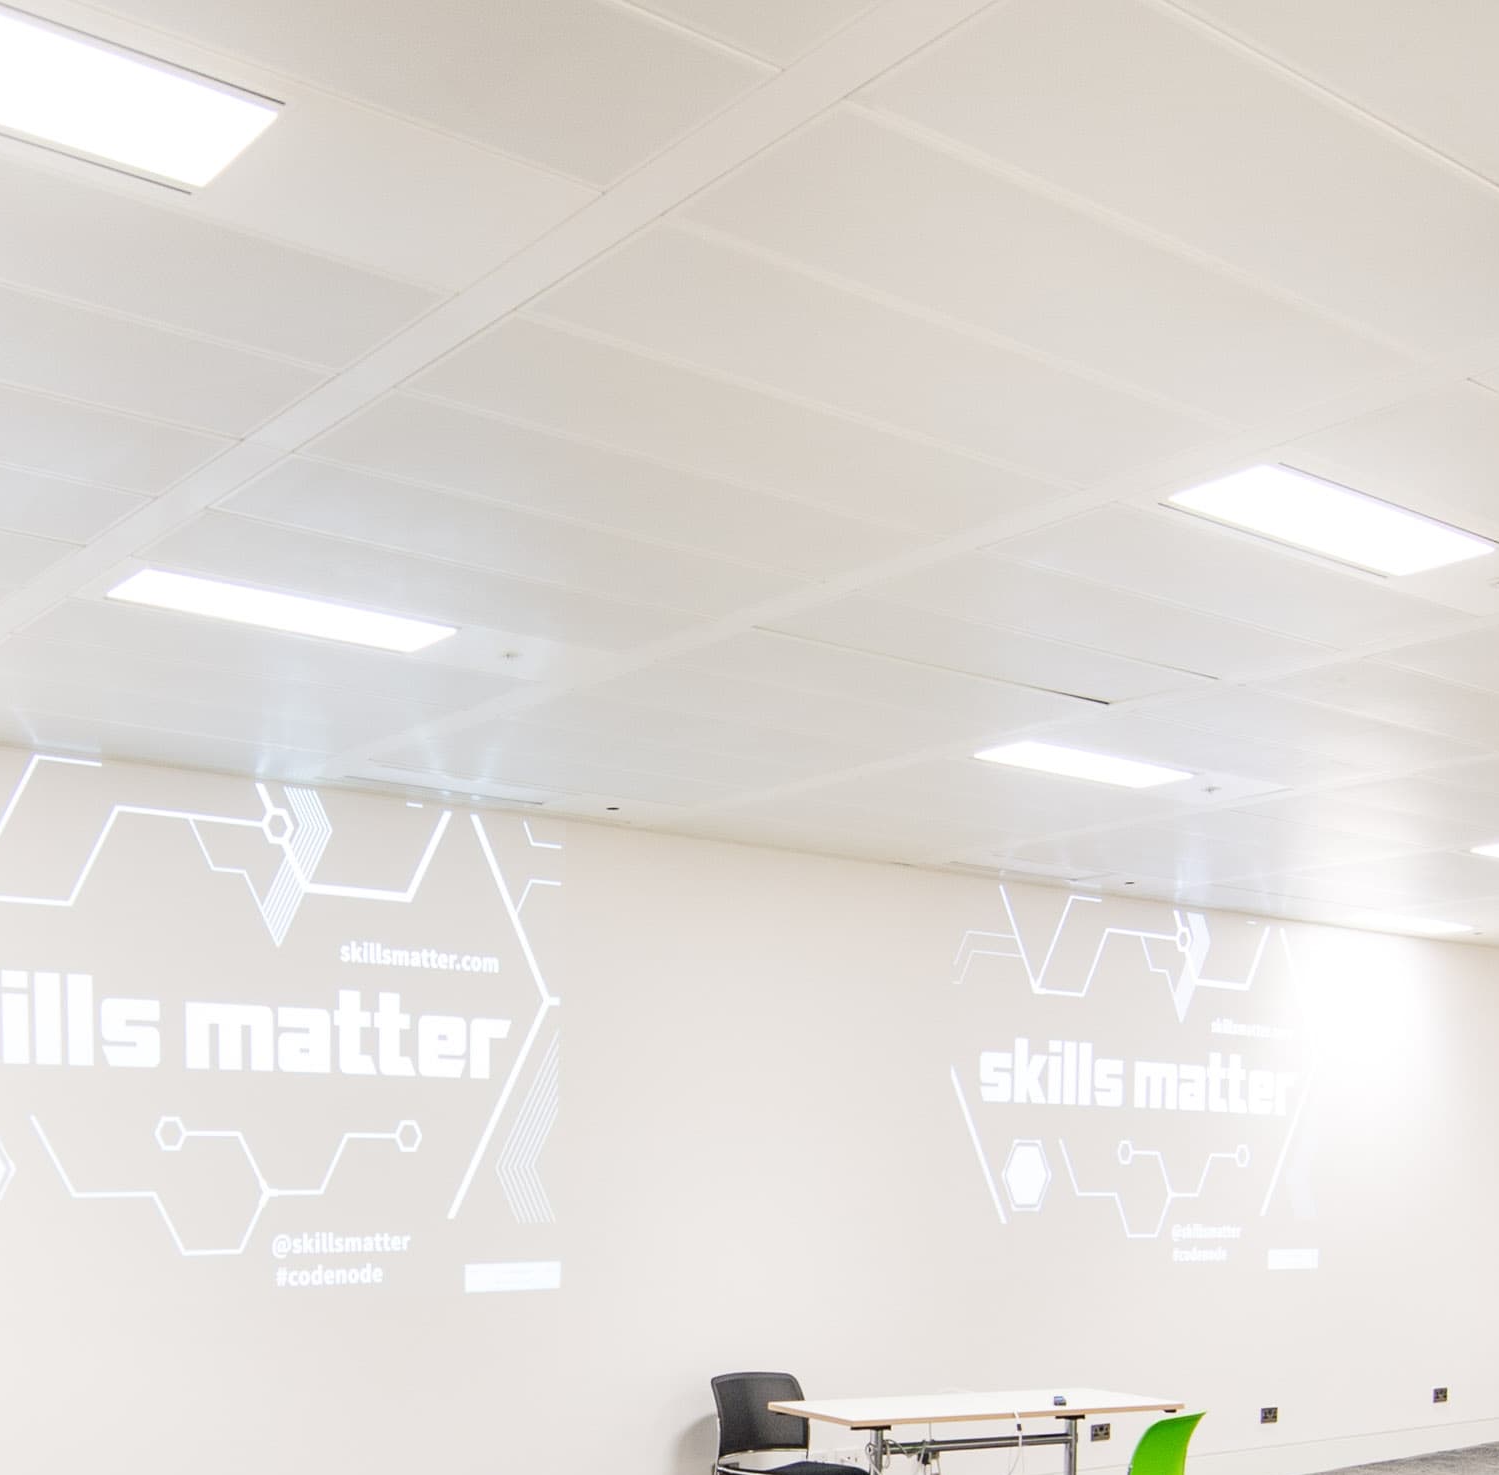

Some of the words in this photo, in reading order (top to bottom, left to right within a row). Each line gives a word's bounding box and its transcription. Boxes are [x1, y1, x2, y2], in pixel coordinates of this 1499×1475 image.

[340, 940, 499, 973] skillsmatter.com
[185, 989, 512, 1079] matter
[979, 1037, 1125, 1107] skills
[1133, 1052, 1298, 1116] matter
[272, 1231, 411, 1259] @skillsmatter
[276, 1263, 384, 1288] #codenode
